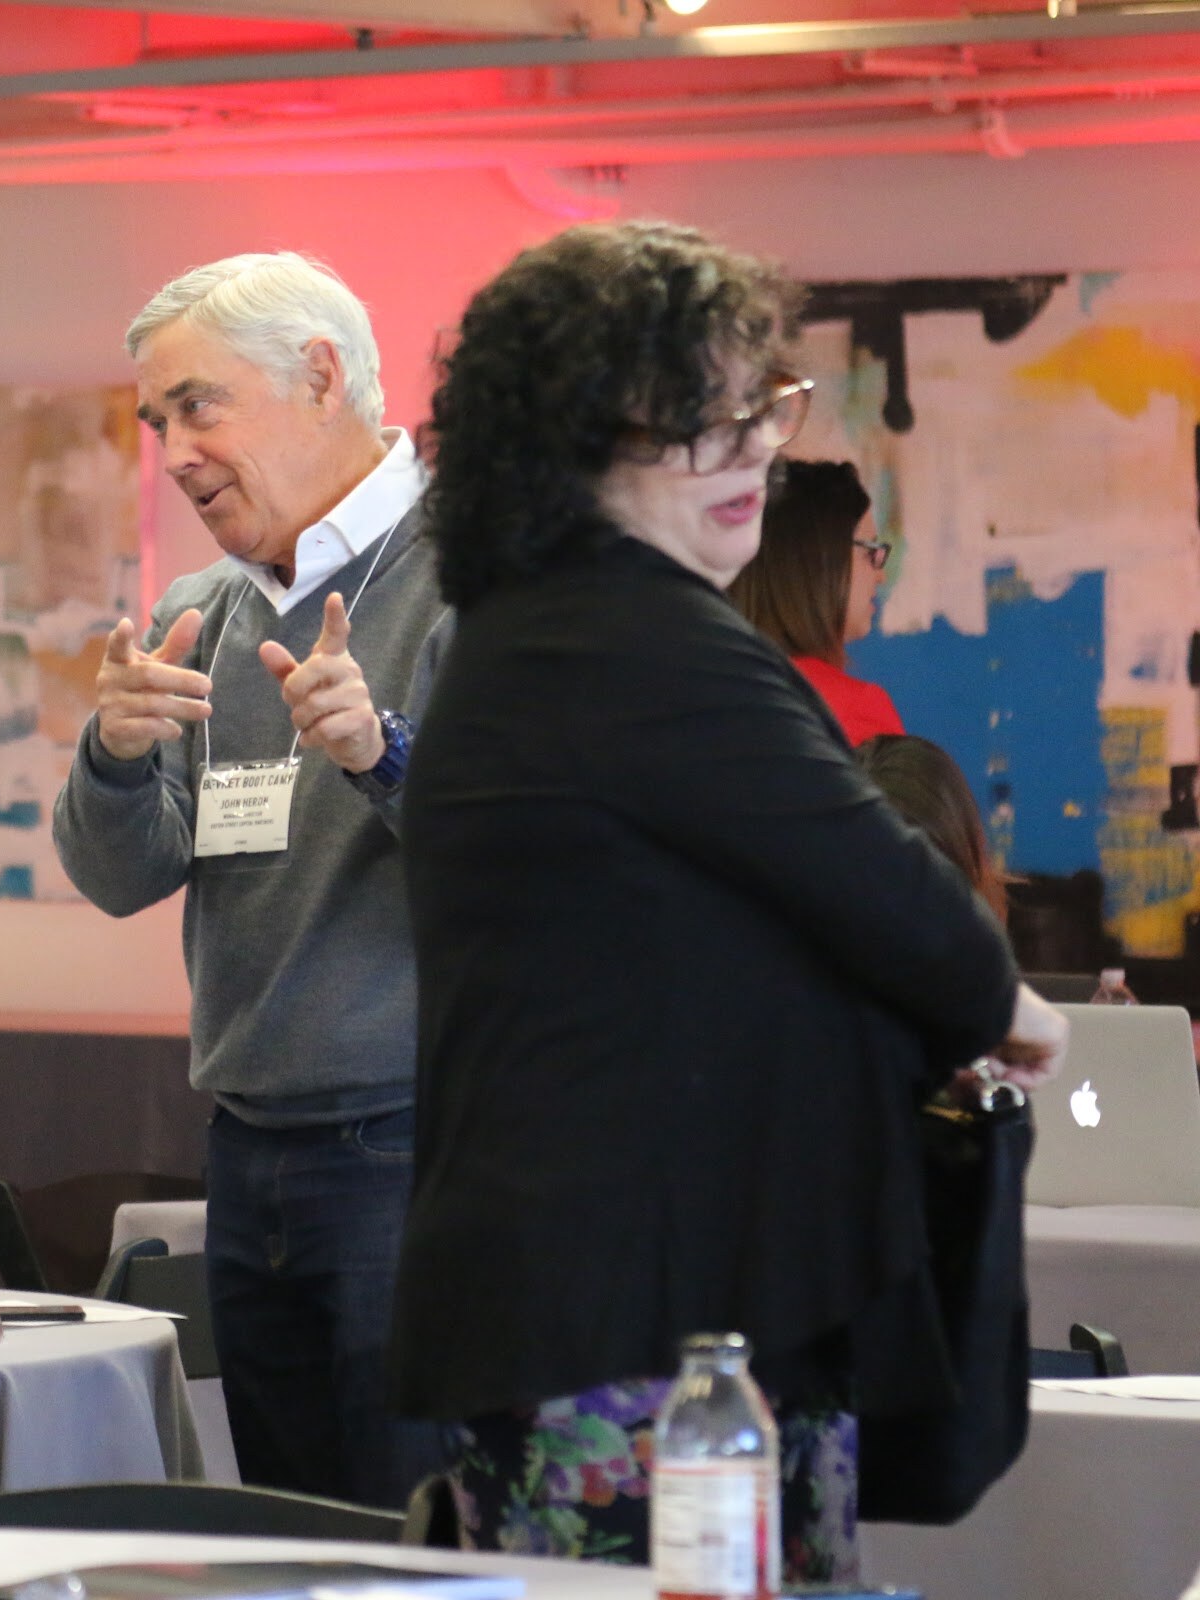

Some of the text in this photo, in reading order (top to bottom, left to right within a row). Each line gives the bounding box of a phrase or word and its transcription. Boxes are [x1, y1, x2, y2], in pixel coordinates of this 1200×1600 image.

[242, 775, 266, 788] BOOT
[267, 773, 294, 786] CAMP
[220, 799, 241, 810] JOHN
